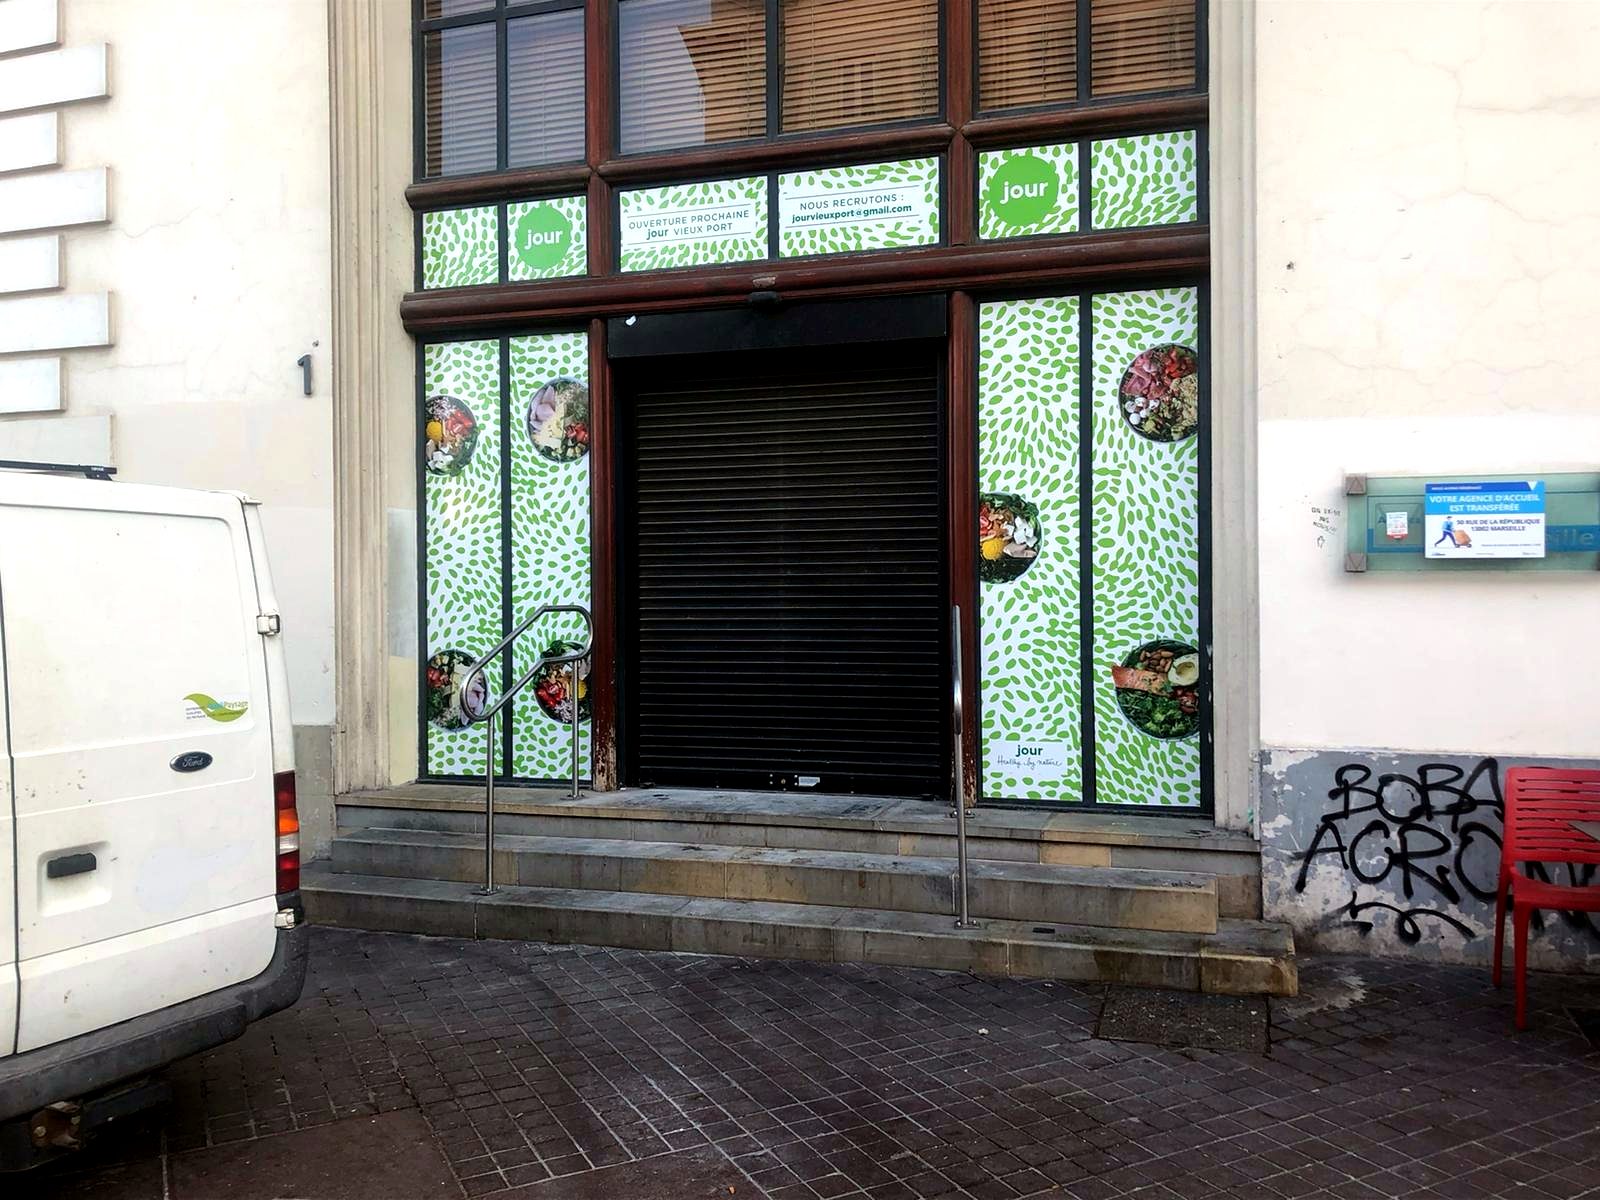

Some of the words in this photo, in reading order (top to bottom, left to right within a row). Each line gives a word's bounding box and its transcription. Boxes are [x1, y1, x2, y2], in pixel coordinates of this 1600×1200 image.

[1001, 178, 1048, 207] jour
[800, 199, 831, 211] NOUS
[833, 194, 898, 208] RECRUTONS
[628, 215, 689, 230] OUVERTURE
[690, 209, 750, 224] PROCHAINE
[791, 203, 912, 224] jourvieuxport@gmail.com
[646, 225, 670, 241] jour
[673, 225, 704, 237] VIEUX
[706, 221, 733, 233] PORT
[523, 228, 564, 252] jour
[297, 354, 312, 396] 1
[1429, 495, 1458, 504] VOTRE
[1459, 494, 1493, 503] AGENCE
[1495, 492, 1541, 502] D'ACCUEIL
[1449, 504, 1465, 513] EST
[1466, 501, 1521, 512] TRANSFÉRÉE
[1479, 518, 1489, 526] DE
[1015, 744, 1044, 758] jour
[182, 756, 204, 768] Ford
[997, 755, 1021, 768] Healthy
[1038, 758, 1062, 766] nature
